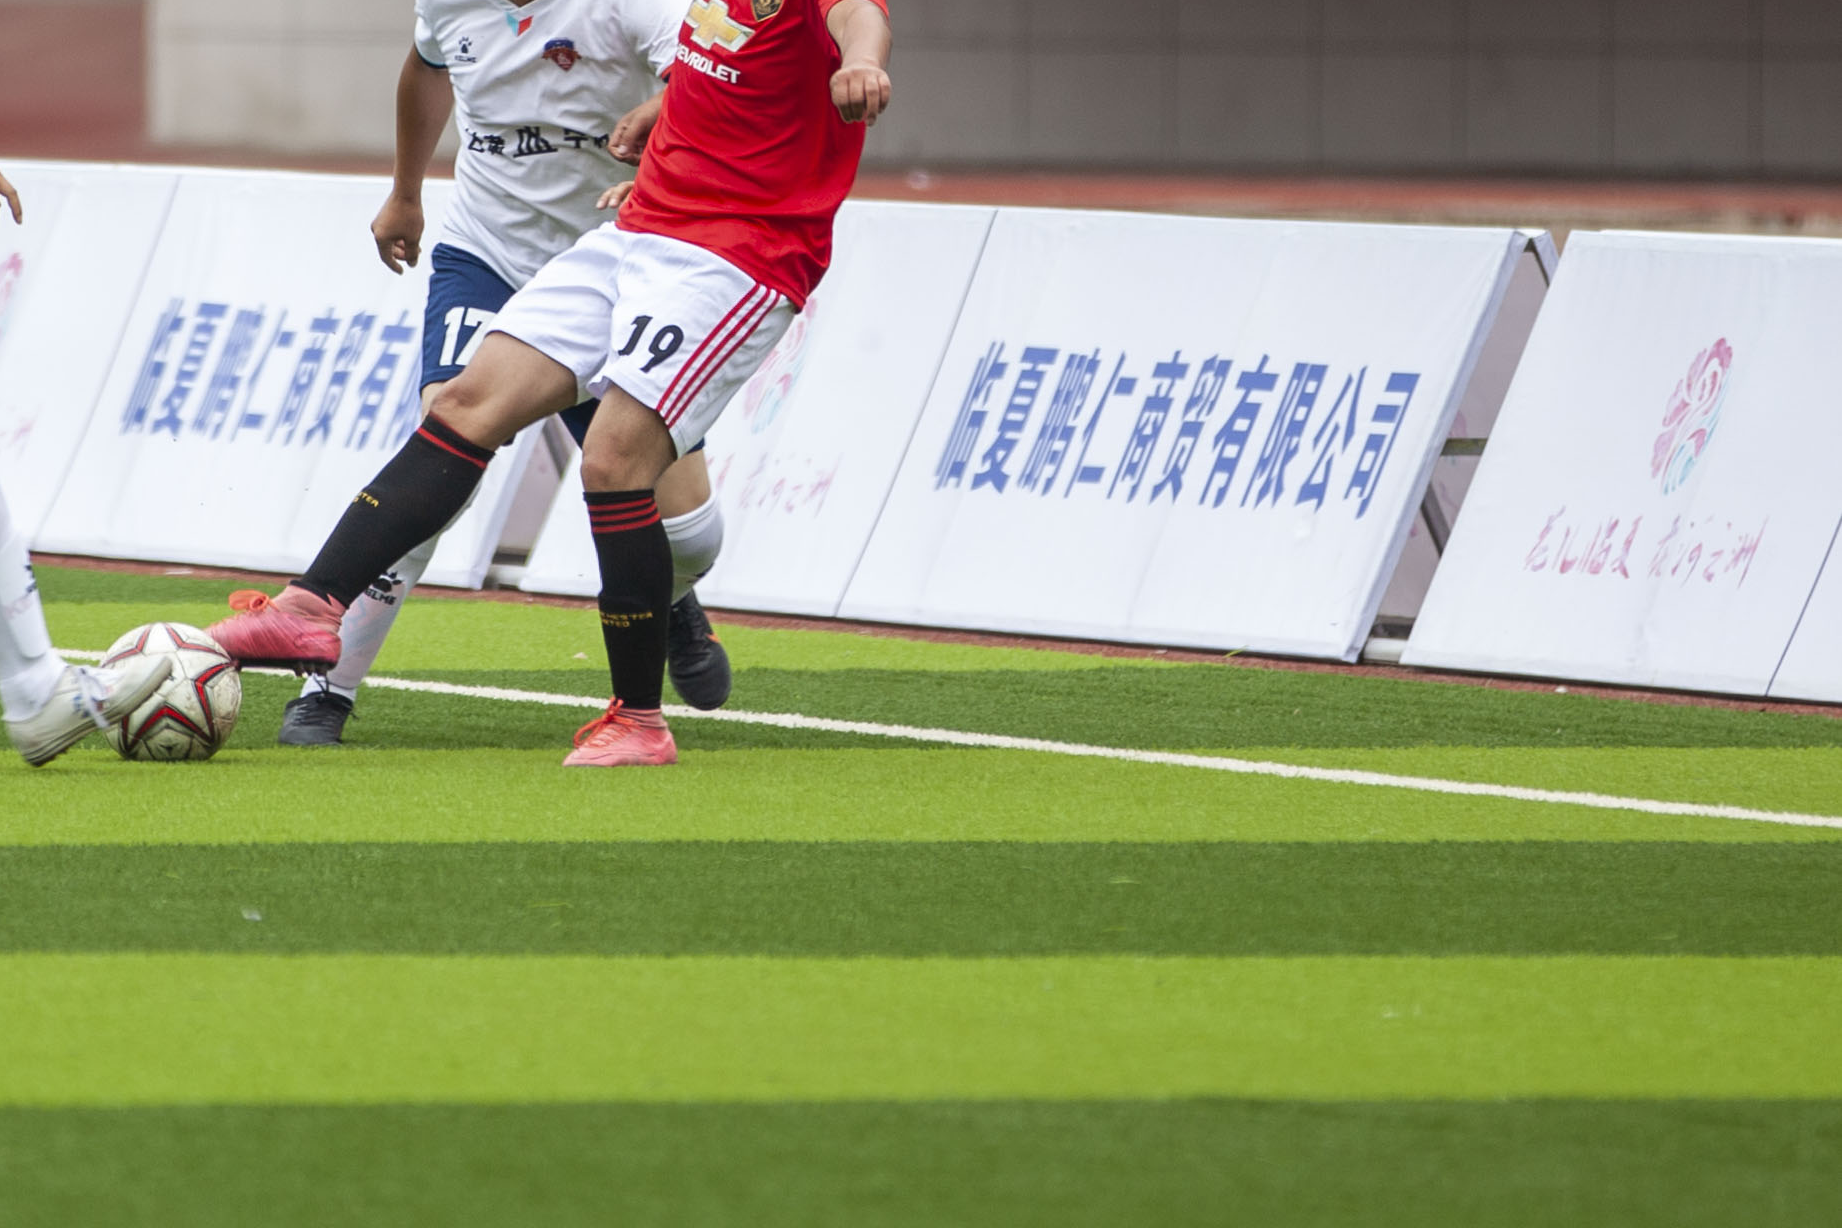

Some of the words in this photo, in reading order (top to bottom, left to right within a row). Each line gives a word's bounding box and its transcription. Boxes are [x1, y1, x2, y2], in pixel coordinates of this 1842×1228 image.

[675, 43, 742, 84] EVROLET
[439, 306, 498, 367] 17
[618, 315, 685, 373] 19
[934, 340, 1422, 518] 临夏鹏仁商贸有限公司
[365, 587, 396, 605] ELME
